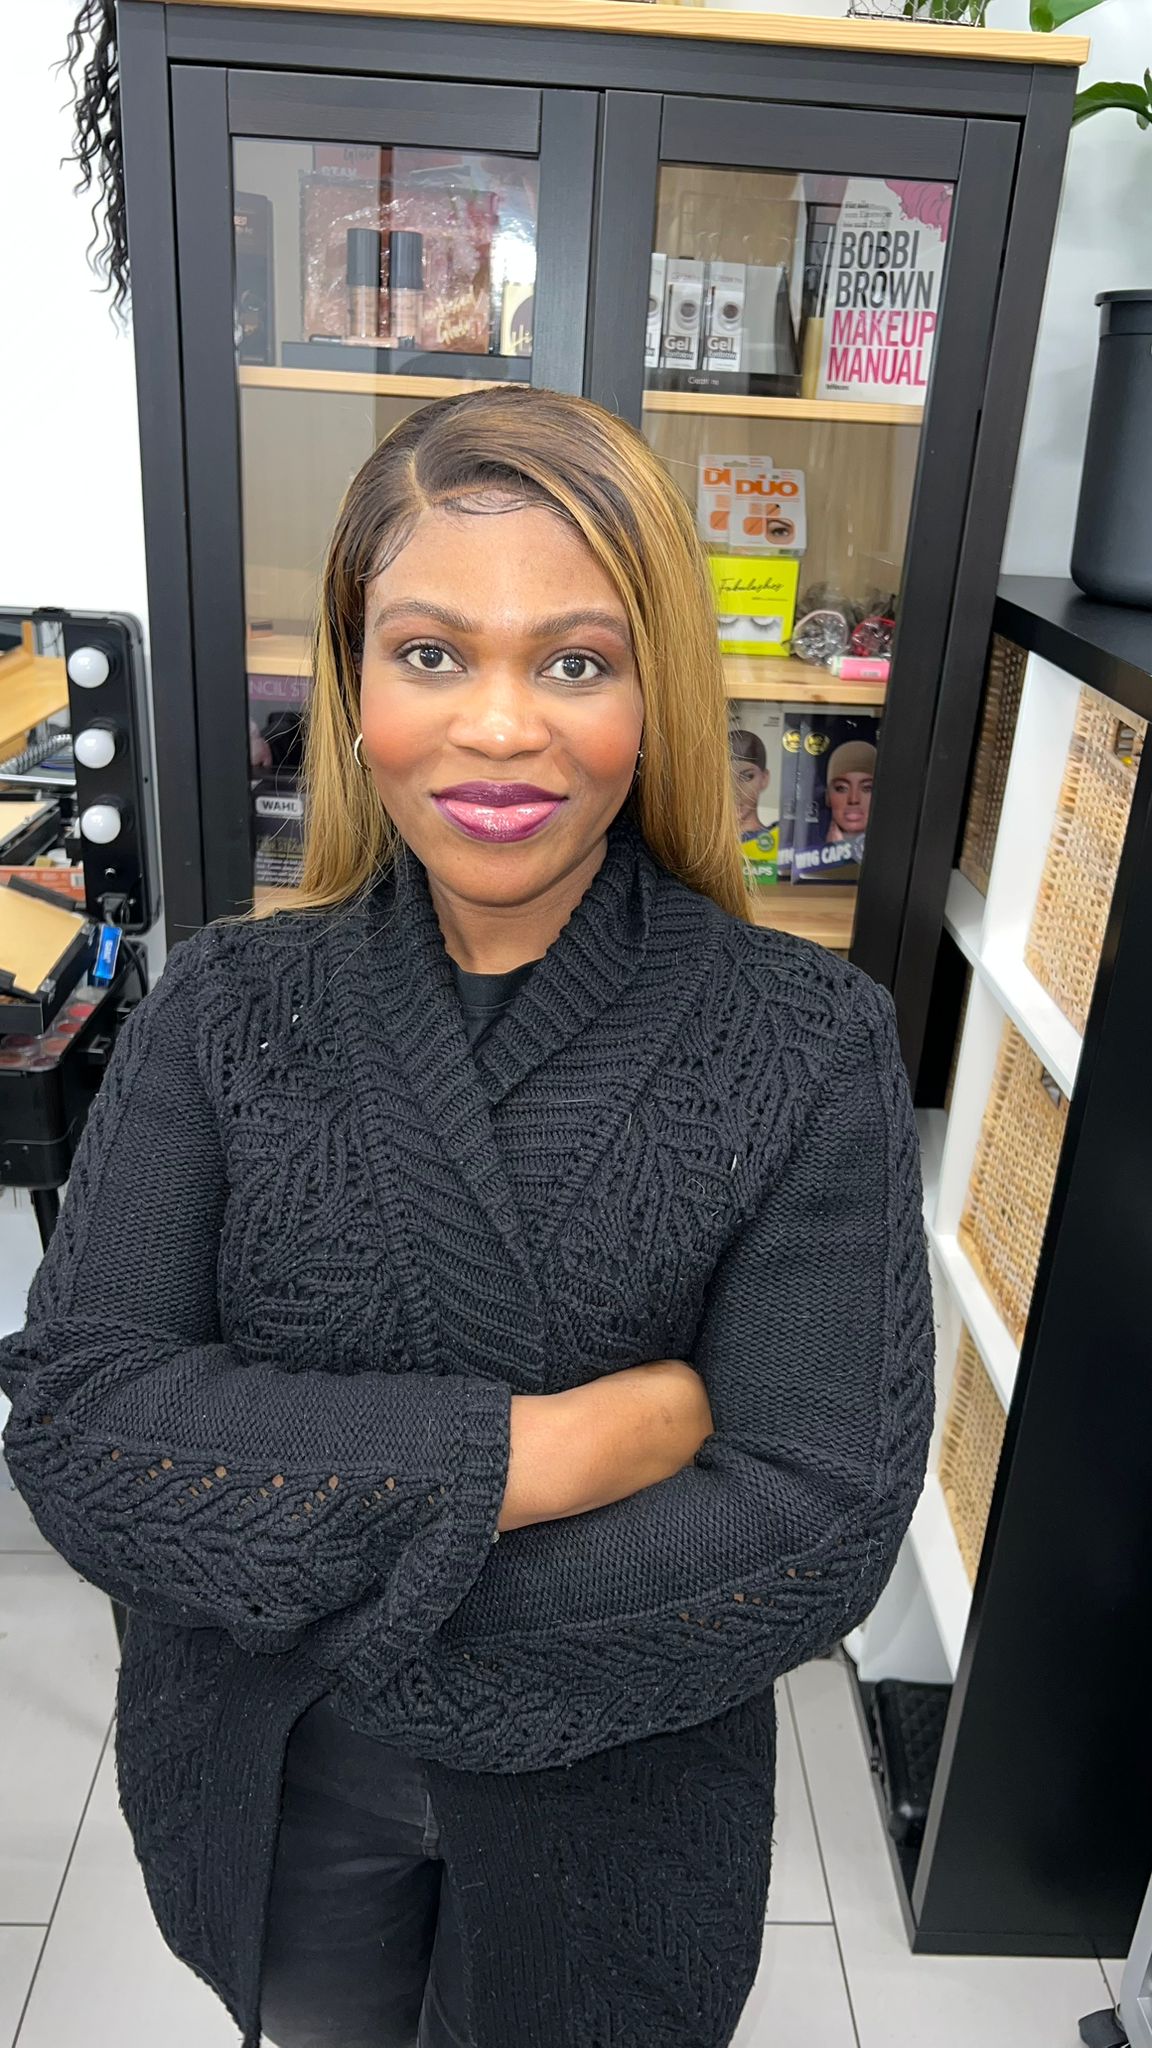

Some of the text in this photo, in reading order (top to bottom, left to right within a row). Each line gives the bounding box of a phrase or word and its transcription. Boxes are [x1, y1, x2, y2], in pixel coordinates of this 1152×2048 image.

[839, 230, 920, 269] BOBBI
[835, 270, 935, 309] BROWN
[831, 310, 937, 348] MAKEUP
[664, 336, 689, 351] Gel
[707, 337, 732, 352] Gel
[826, 347, 928, 387] MANUAL
[249, 679, 287, 697] NCIL
[262, 799, 298, 812] WAHL
[795, 842, 852, 869] WIG CAPS
